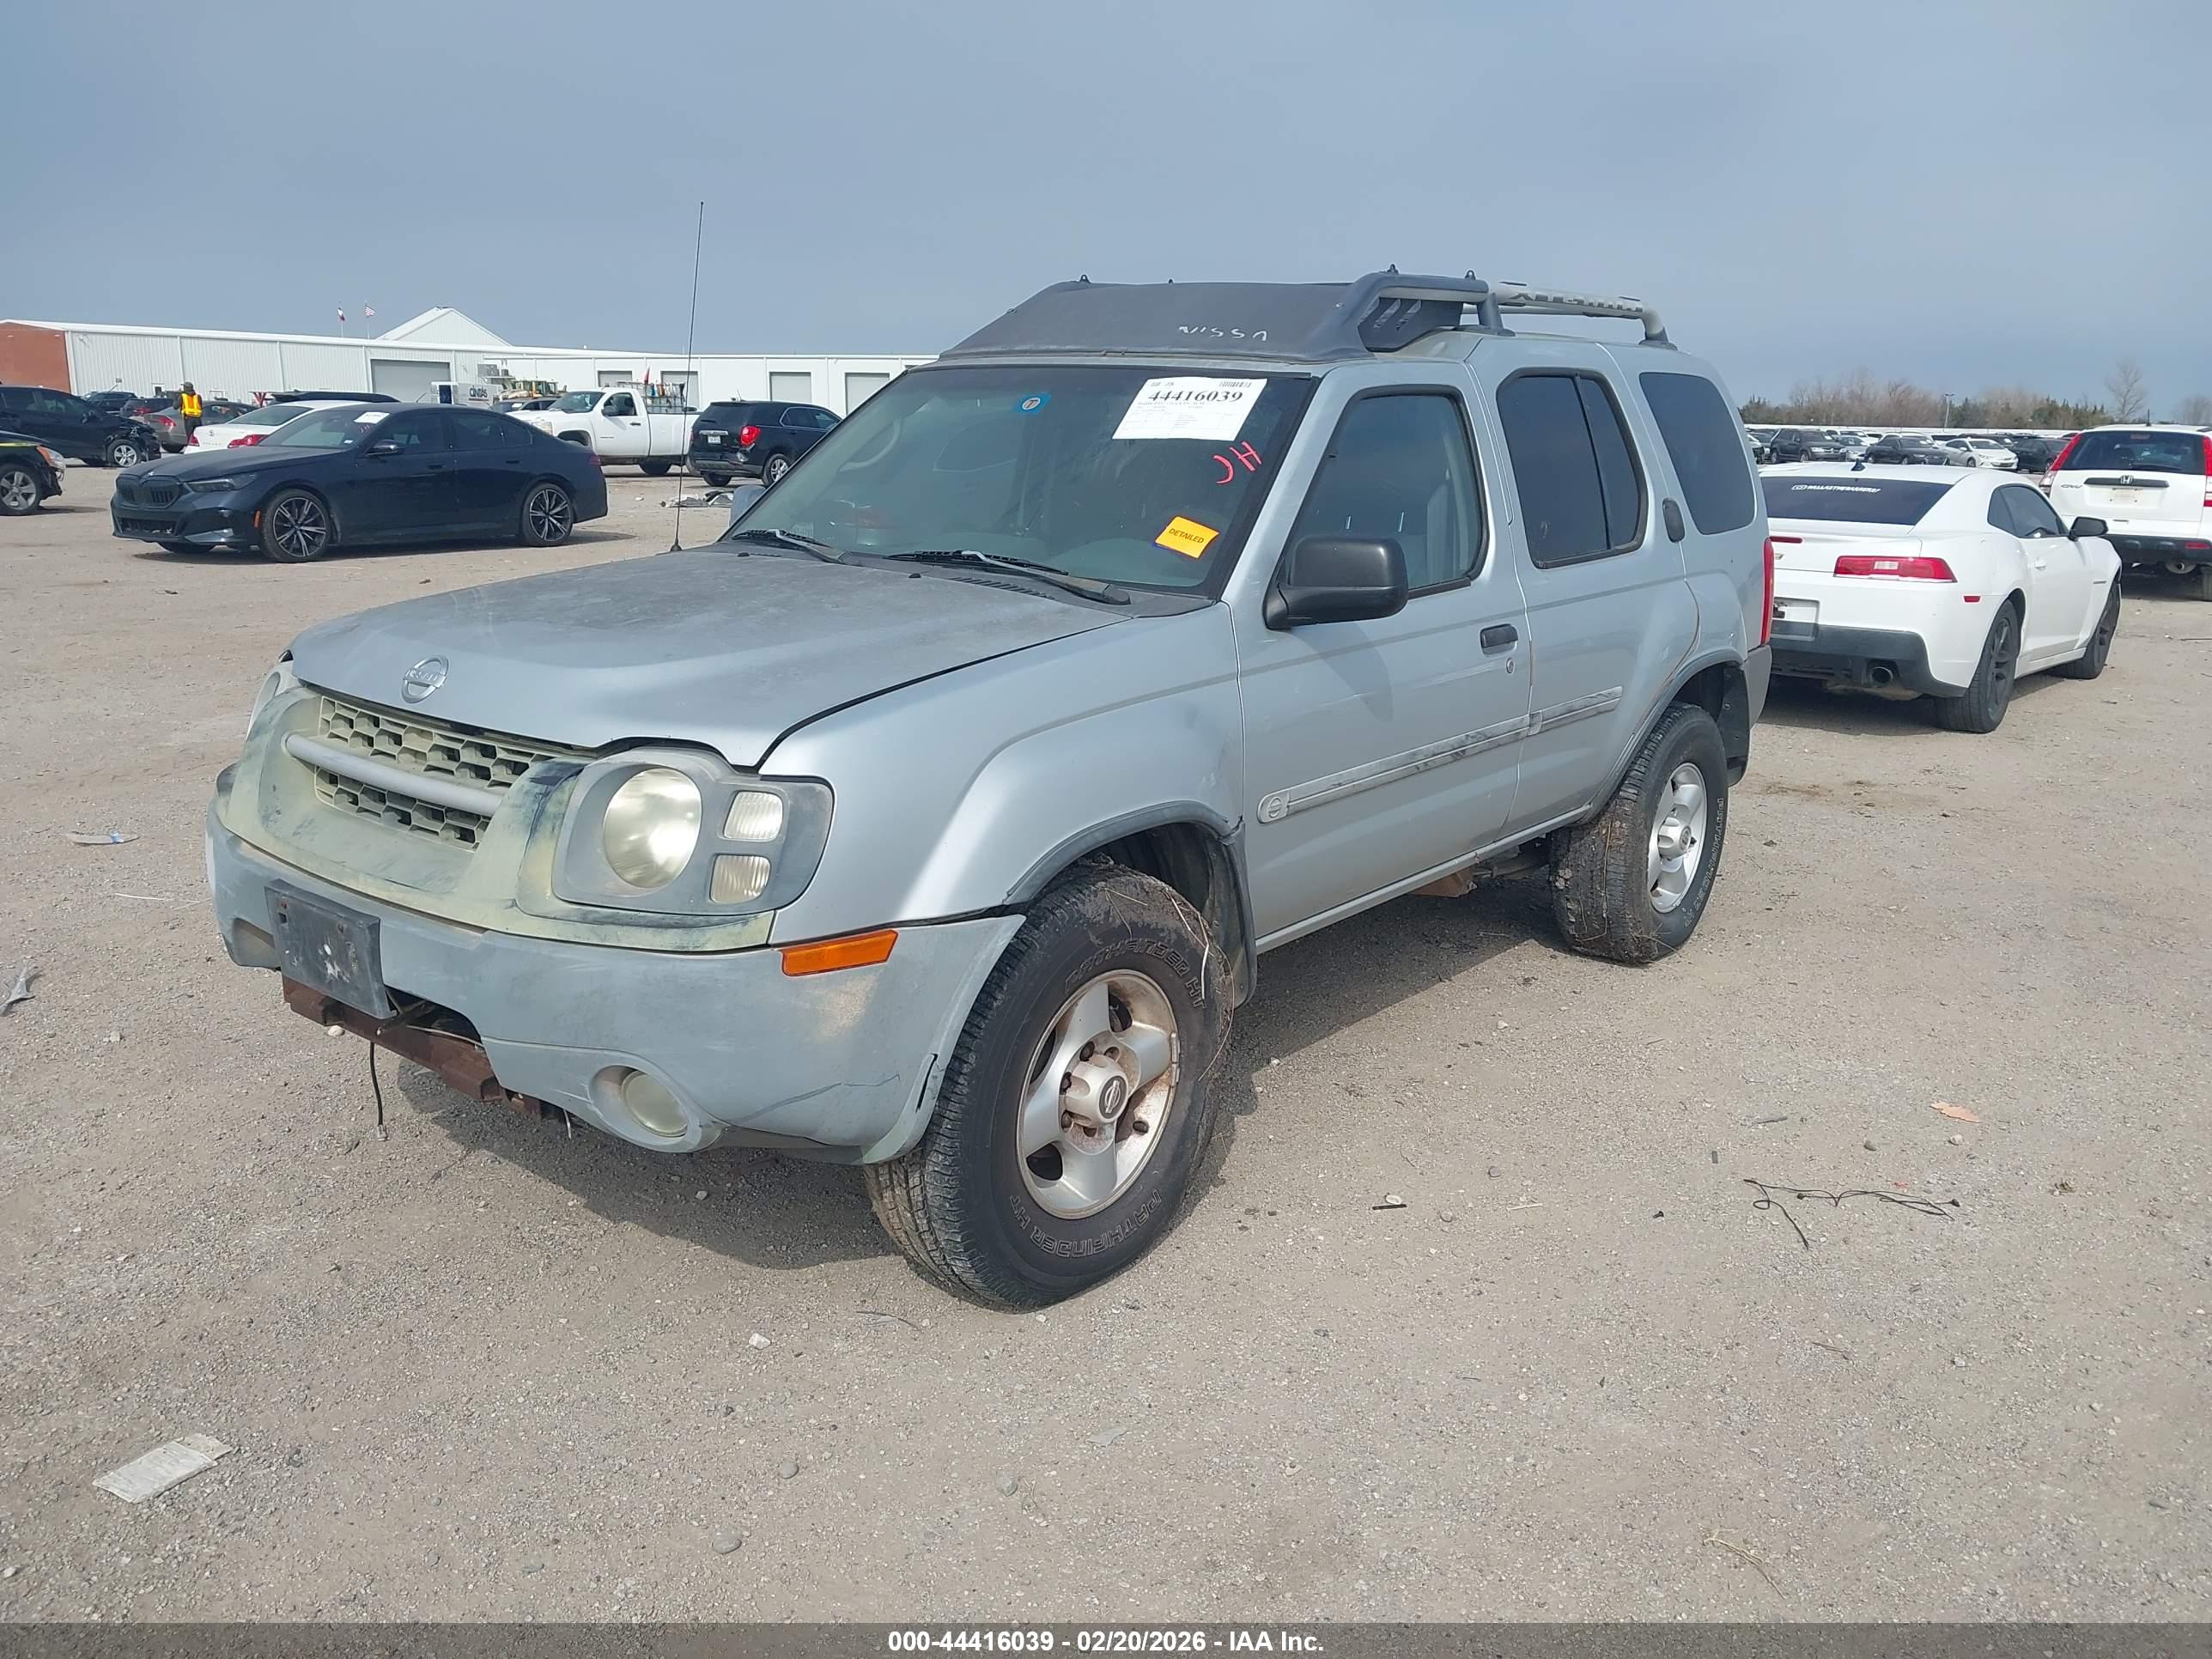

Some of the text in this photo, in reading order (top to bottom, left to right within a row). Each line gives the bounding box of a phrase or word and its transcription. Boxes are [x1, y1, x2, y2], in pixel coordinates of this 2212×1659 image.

[1148, 390, 1243, 403] 44416039
[1169, 528, 1205, 544] DETAILED
[1064, 937, 1207, 1010] PATHFINDER HT
[1009, 1194, 1031, 1231] HT
[1030, 1188, 1162, 1258] PATHFINDER
